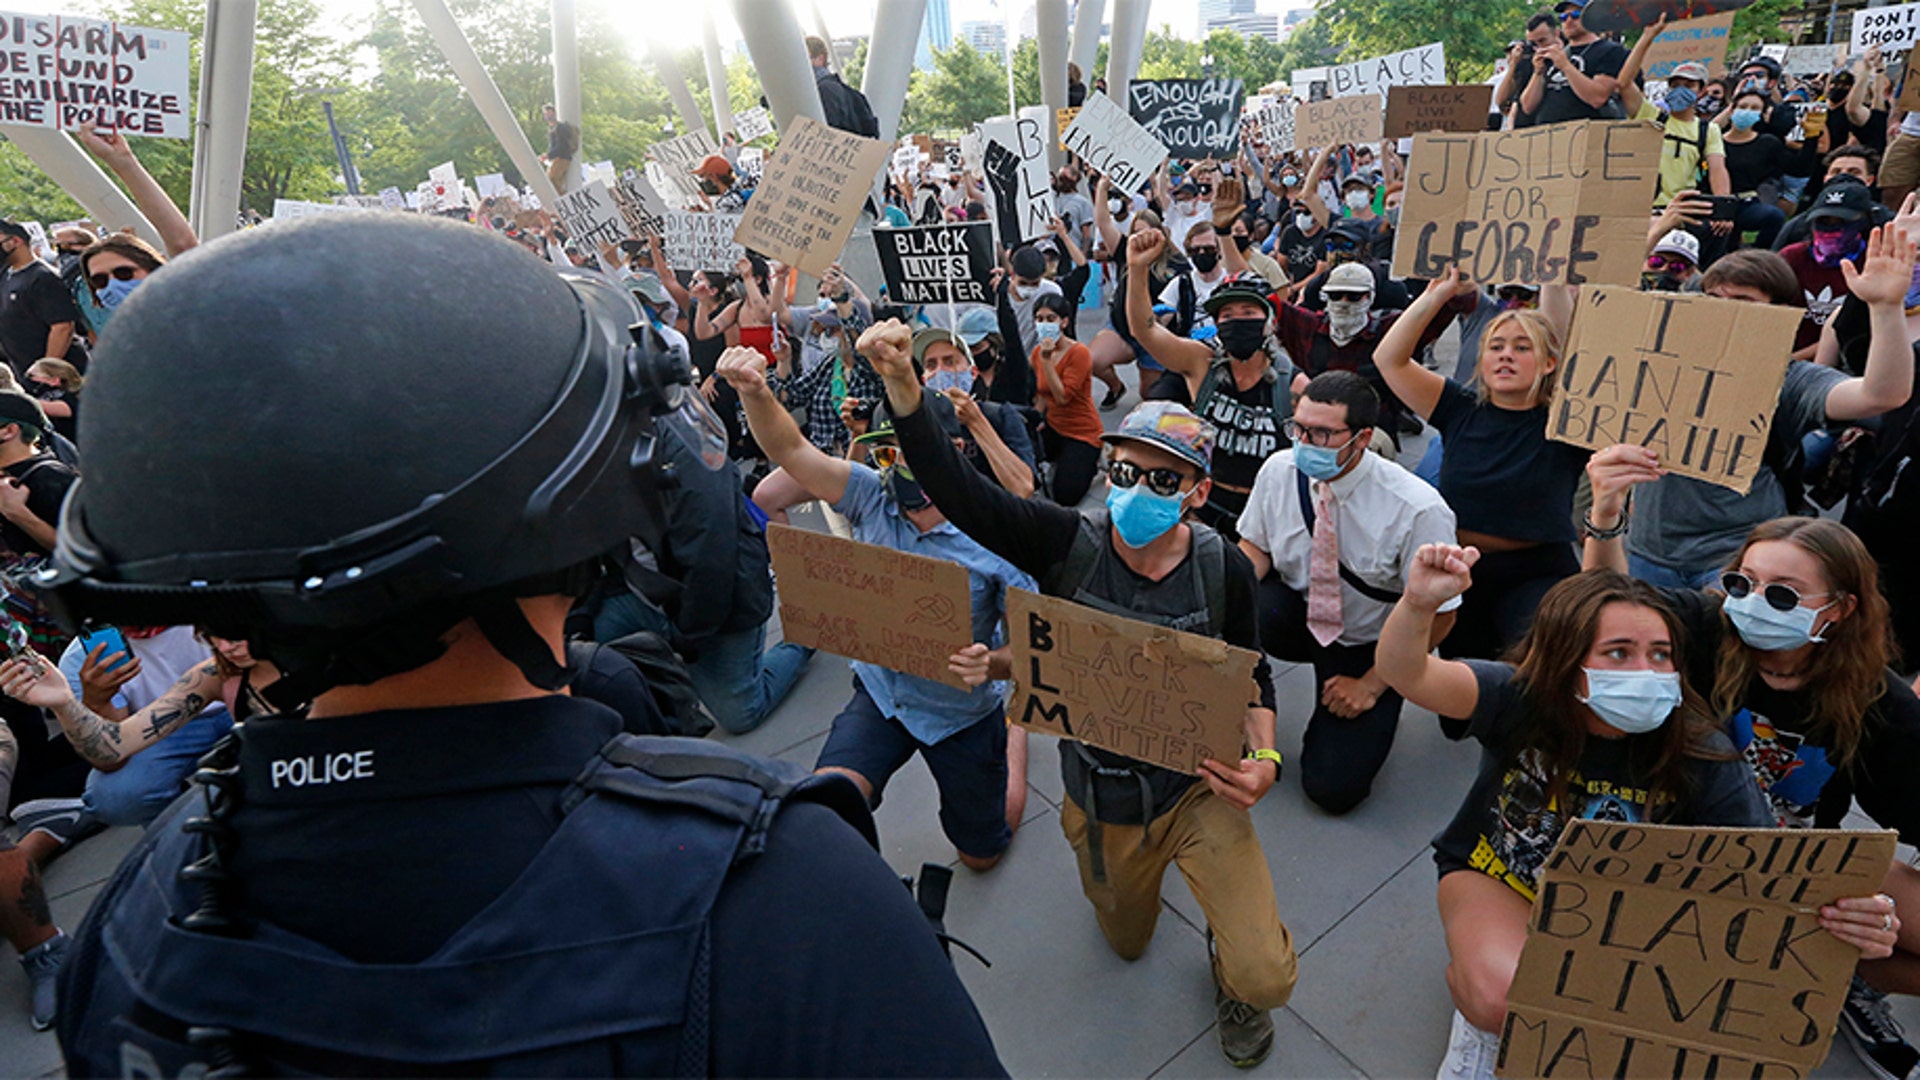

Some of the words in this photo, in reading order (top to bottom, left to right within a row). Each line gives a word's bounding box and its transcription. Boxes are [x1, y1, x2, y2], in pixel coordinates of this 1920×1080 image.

[1860, 27, 1916, 46] SHOOT
[1334, 48, 1434, 93] BLACK
[0, 78, 181, 114] EMILITARIZE
[1131, 79, 1241, 111] ENOUGH
[1159, 102, 1203, 124] IS
[1309, 99, 1375, 124] BLACK
[1408, 91, 1465, 105] BLACK
[1417, 106, 1454, 117] LIVES
[0, 100, 44, 123] THE
[64, 104, 164, 133] POLICE
[1089, 101, 1162, 160] ENOUGH
[1320, 118, 1370, 133] LIVES
[1405, 119, 1458, 130] MATTER
[1418, 124, 1644, 196] JUSTICE
[557, 187, 602, 221] BLACK
[1482, 186, 1548, 222] FOR
[667, 213, 737, 235] DISARM
[894, 228, 970, 255] BLACK
[903, 256, 967, 280] LIVES
[1412, 214, 1600, 287] GEORGE
[900, 281, 986, 302] MATTER
[1214, 426, 1277, 459] UMP
[782, 602, 859, 638] BLACK
[817, 628, 941, 682] MATTER
[1029, 611, 1188, 694] BLACK
[1031, 655, 1206, 739] LIVES
[1022, 693, 1216, 774] MATTER
[271, 750, 375, 787] POLICE
[1564, 823, 1647, 853] NO
[1668, 832, 1886, 878] JUSTICE
[1548, 850, 1631, 879] NO
[1644, 861, 1823, 903] PEACE
[1537, 881, 1825, 982] BLACK
[1554, 949, 1825, 1047] LIVES
[1500, 1011, 1800, 1080] MATT
